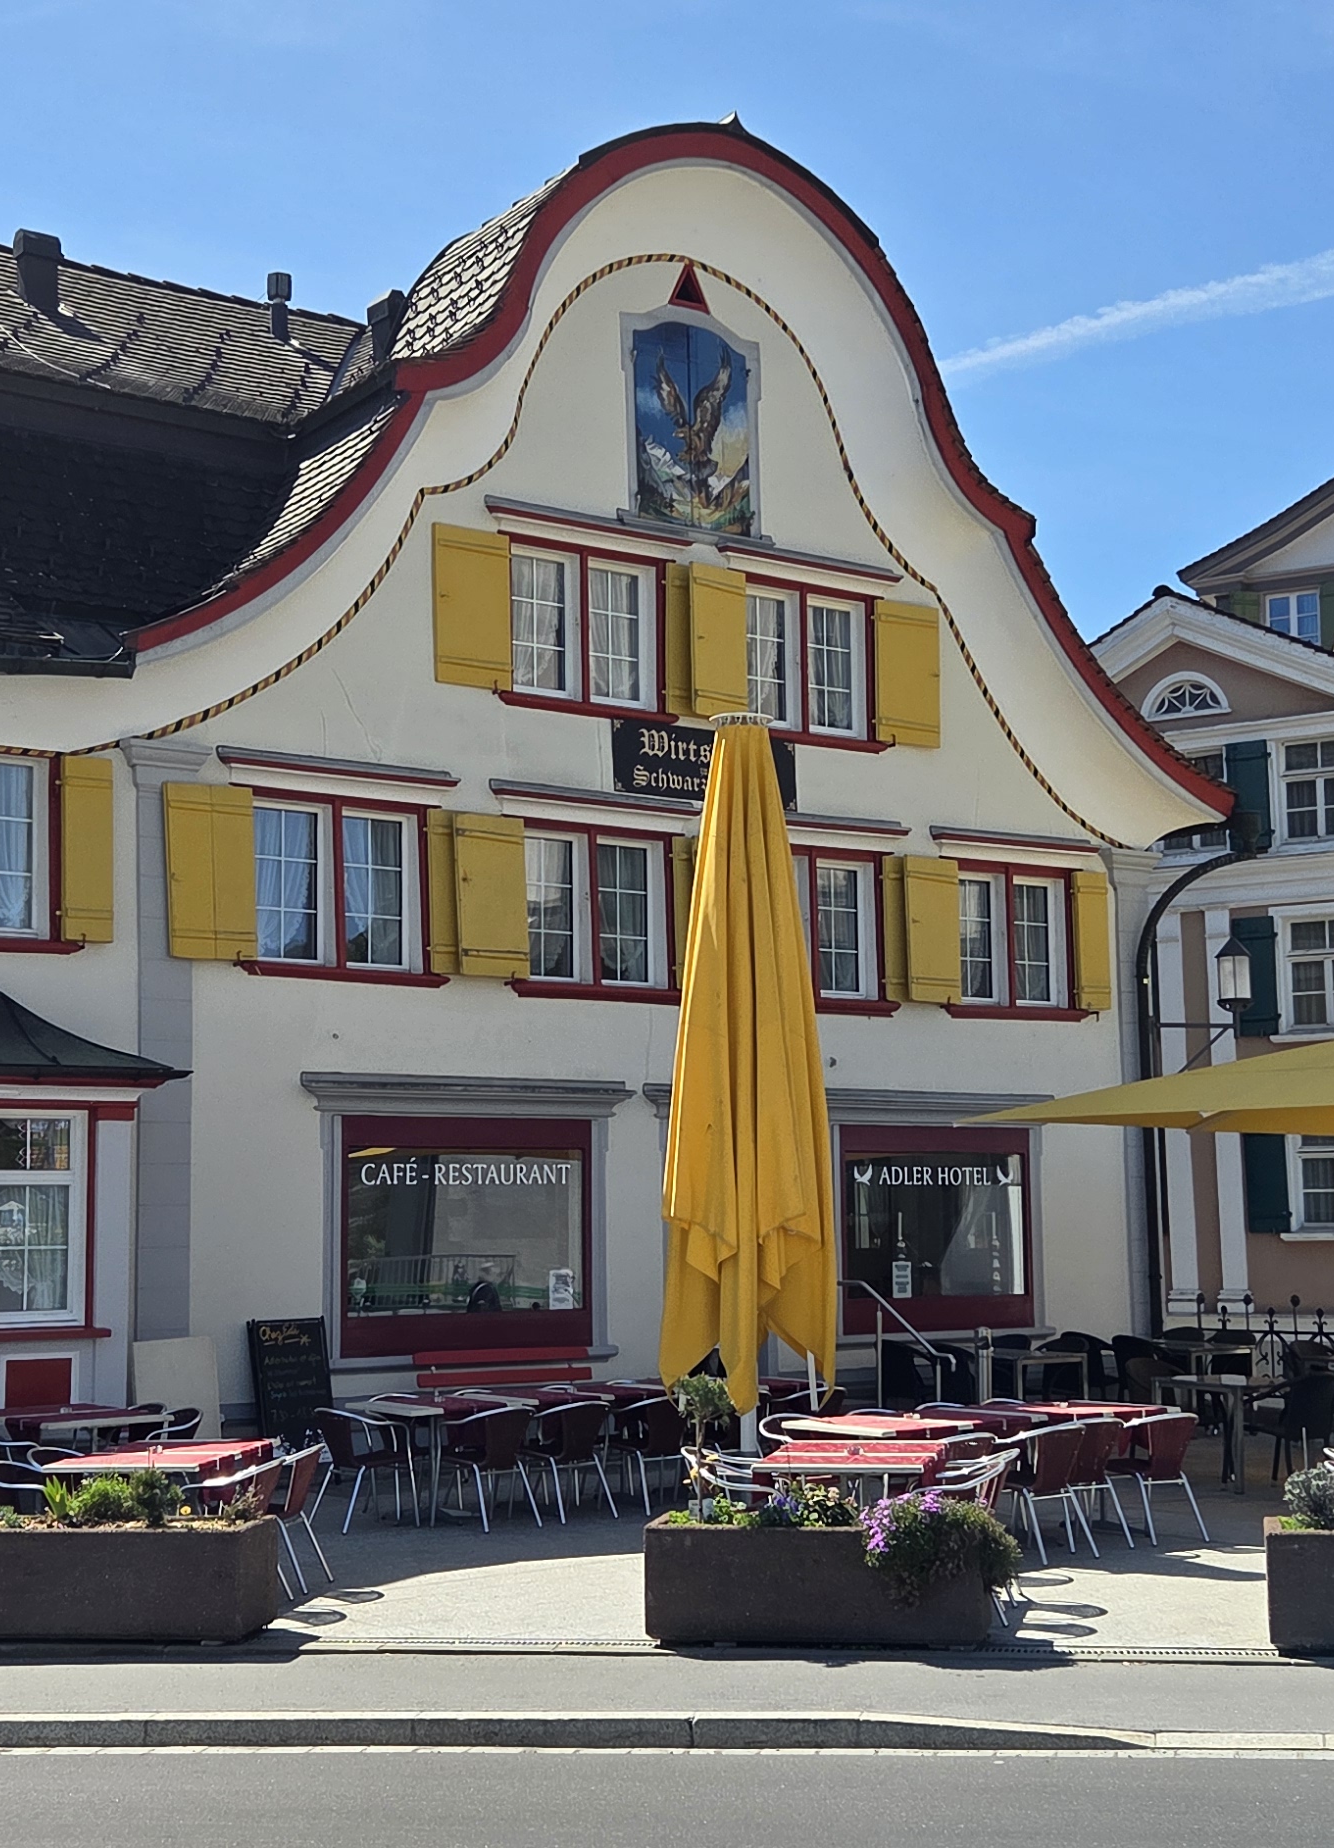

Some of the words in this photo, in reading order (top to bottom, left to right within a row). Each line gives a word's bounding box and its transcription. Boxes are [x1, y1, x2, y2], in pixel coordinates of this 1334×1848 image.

[360, 1156, 418, 1186] CAFÉ
[433, 1163, 572, 1186] RESTAURANT
[878, 1166, 934, 1186] ADLER
[937, 1167, 992, 1186] HOTEL
